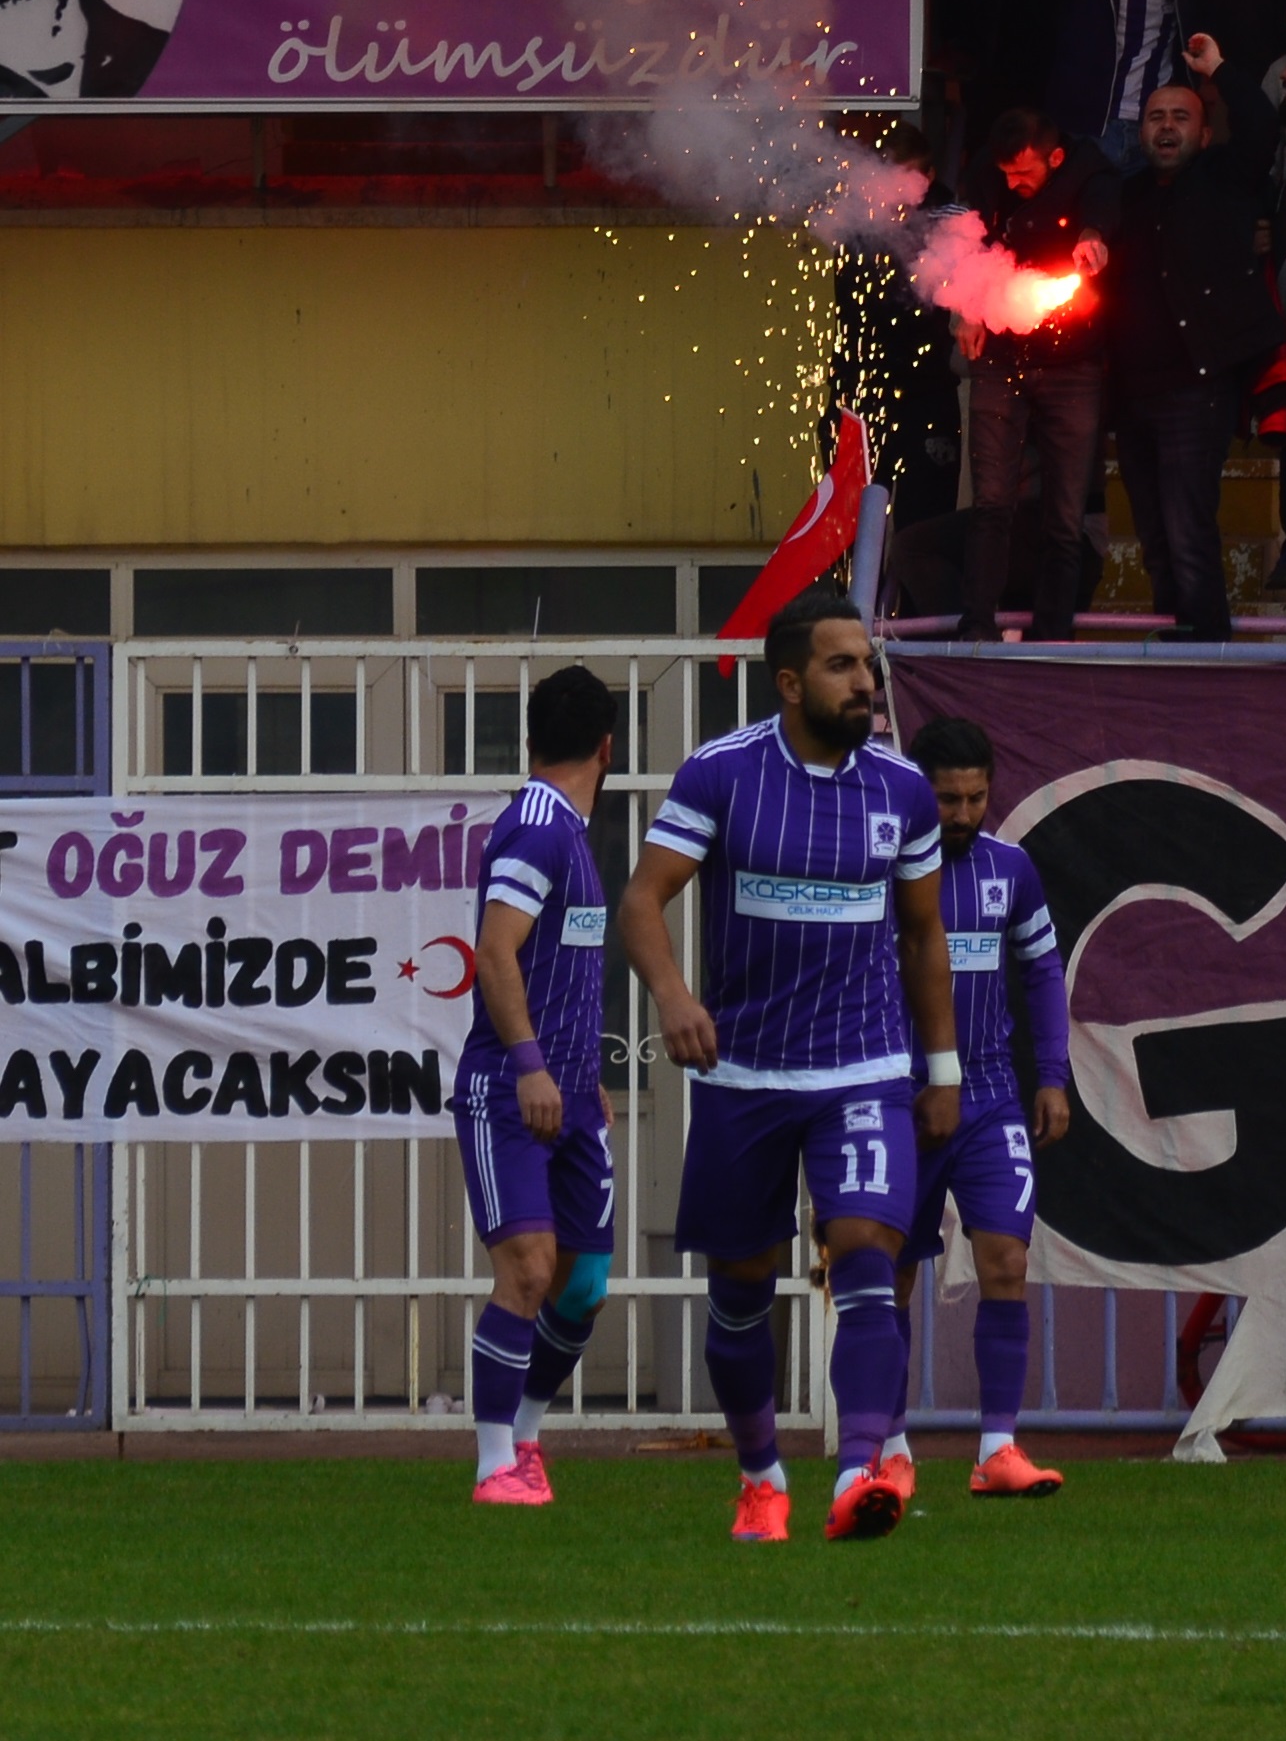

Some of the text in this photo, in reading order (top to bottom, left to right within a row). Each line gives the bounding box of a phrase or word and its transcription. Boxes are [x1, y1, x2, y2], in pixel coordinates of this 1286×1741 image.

[267, 12, 858, 92] ölümsüzdür
[46, 809, 248, 900] OĞUZ
[814, 906, 845, 917] HALAT
[838, 1140, 891, 1195] 11
[1012, 1165, 1034, 1213] 7
